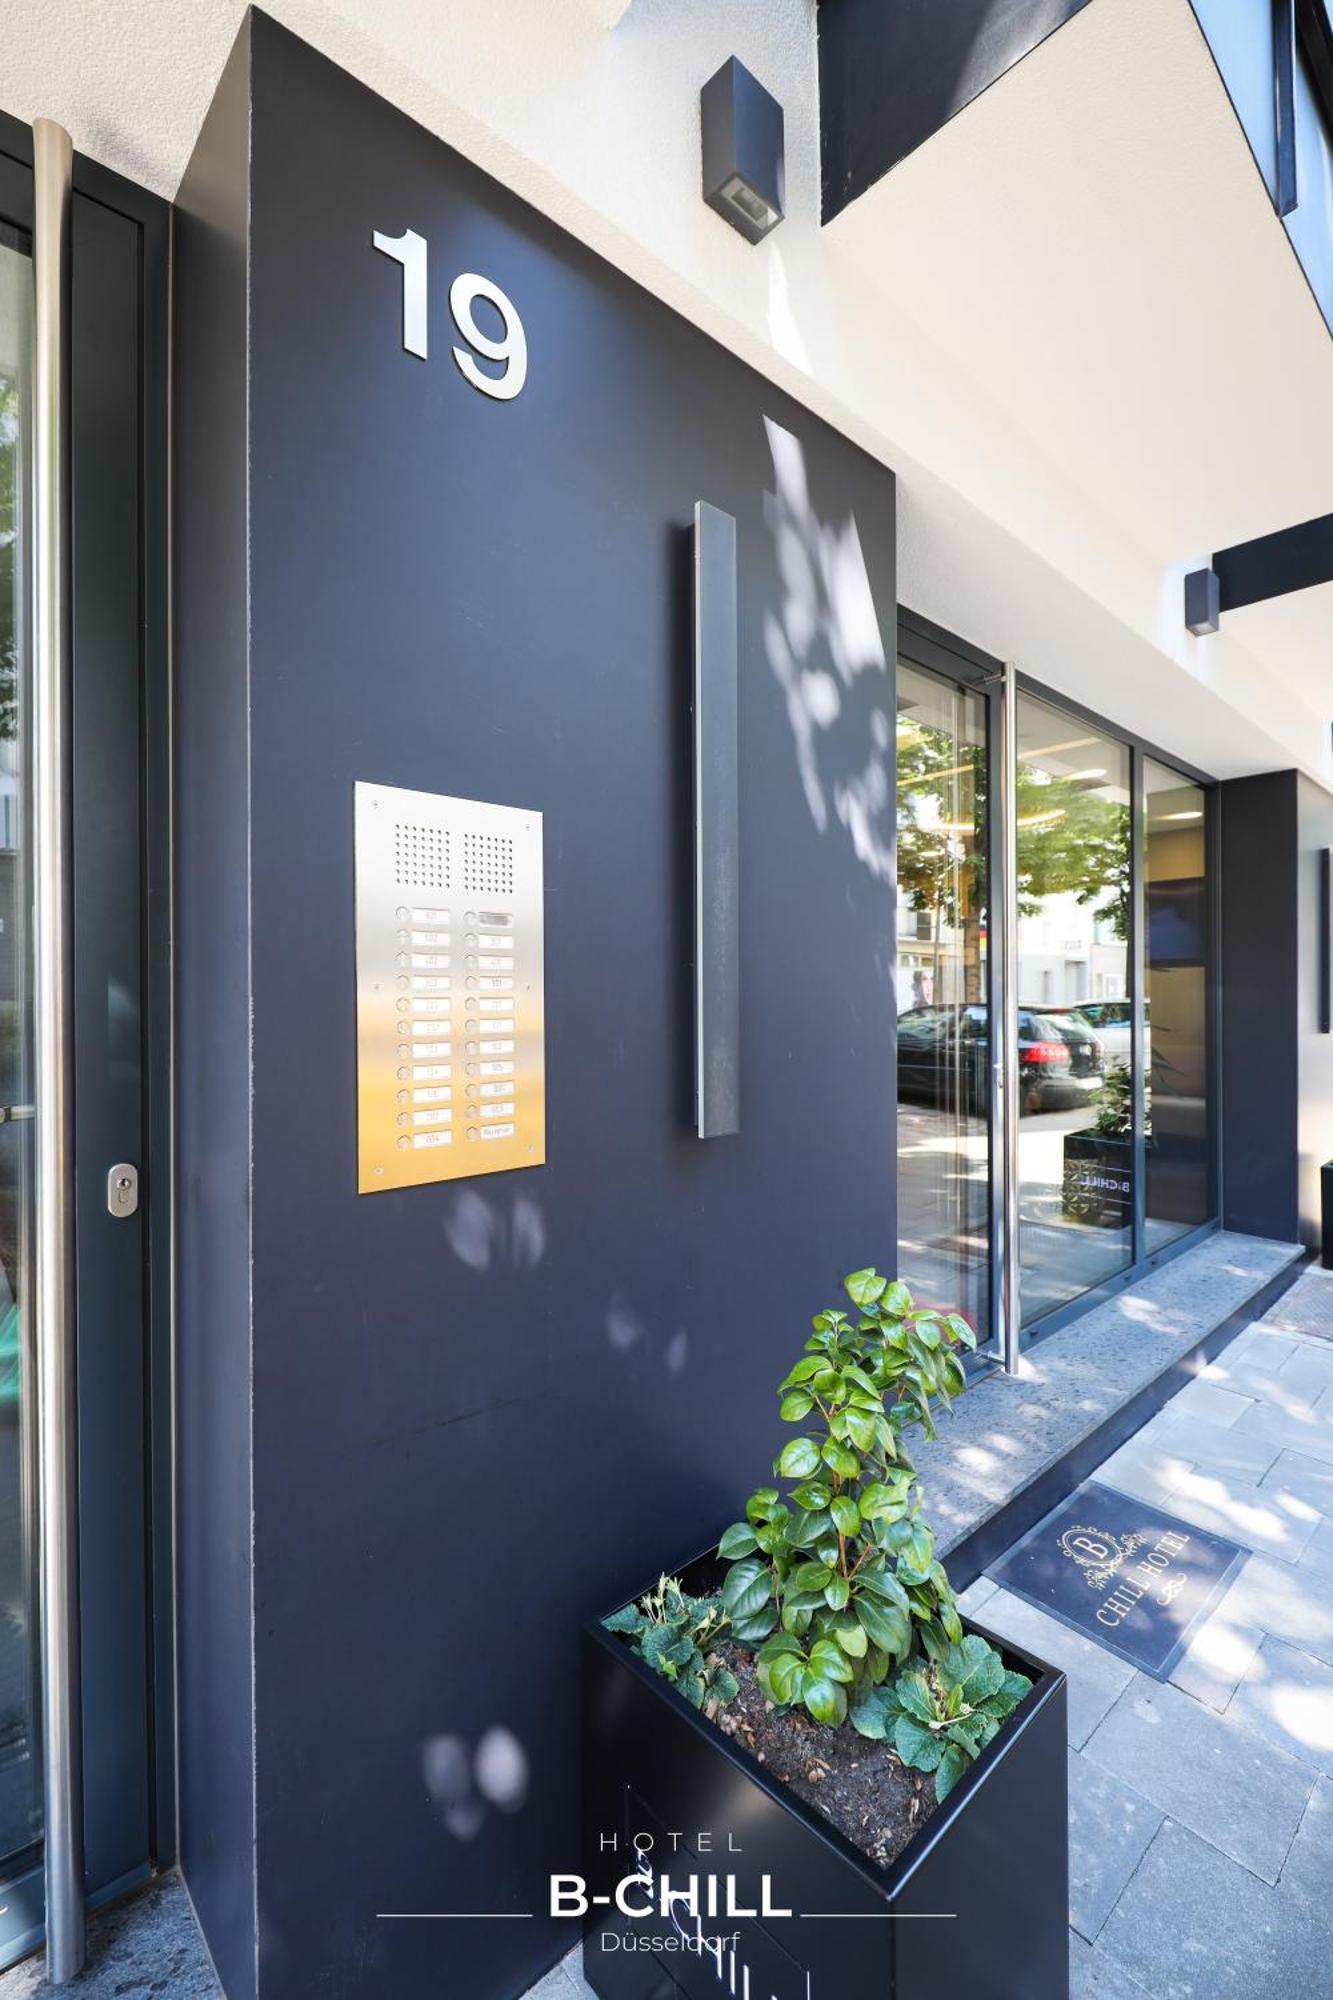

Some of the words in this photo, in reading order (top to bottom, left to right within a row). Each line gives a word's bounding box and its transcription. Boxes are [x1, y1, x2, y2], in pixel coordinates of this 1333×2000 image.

[372, 228, 528, 401] 19
[1073, 1537, 1108, 1559] B
[1096, 1577, 1151, 1626] CHILL
[1136, 1531, 1190, 1577] HOTEL
